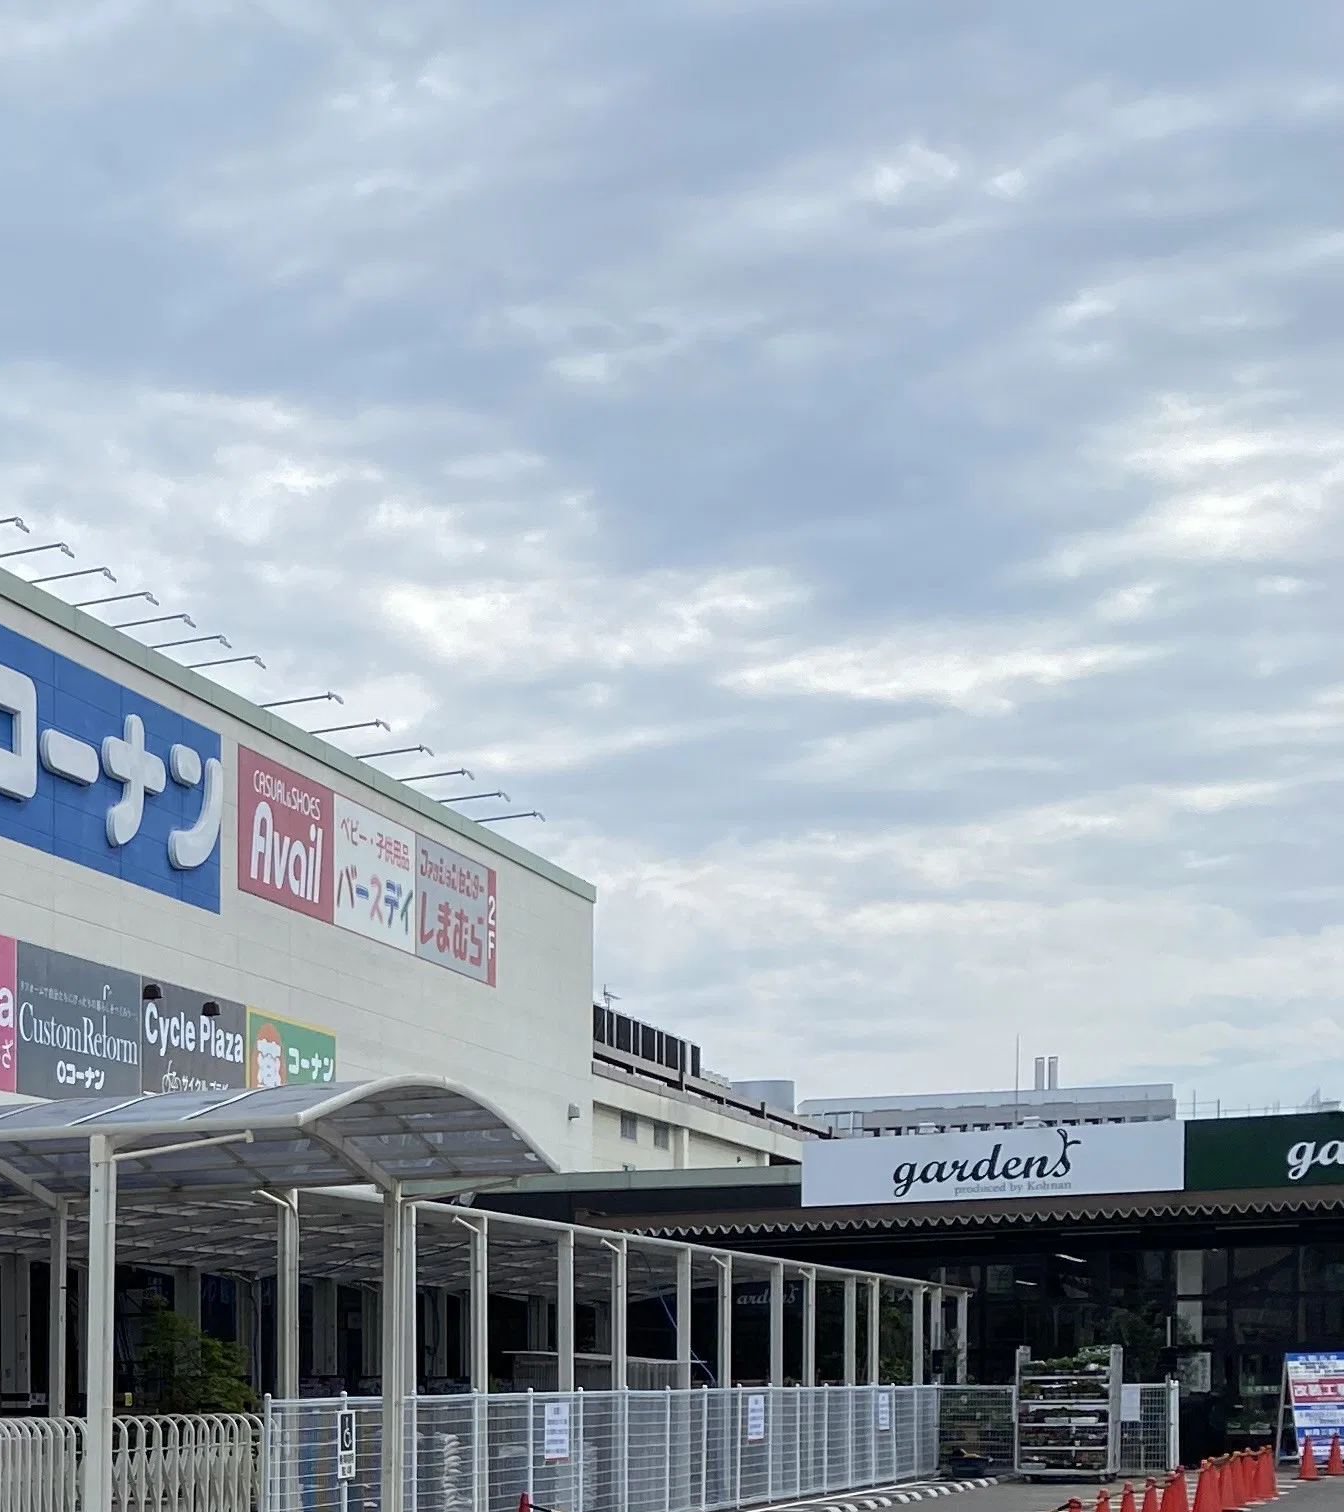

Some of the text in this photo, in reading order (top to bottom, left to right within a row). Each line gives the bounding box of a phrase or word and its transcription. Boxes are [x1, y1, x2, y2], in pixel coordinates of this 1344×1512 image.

[253, 769, 321, 821] CASUAL&SHOES
[250, 801, 323, 904] Avail
[419, 891, 485, 967] しまむら
[145, 1003, 244, 1063] Cycle Plaza
[67, 1060, 105, 1090] コーナン
[288, 1048, 334, 1082] コーナン
[893, 1128, 1081, 1197] gardens
[954, 1179, 1071, 1196] produced by Kohnan
